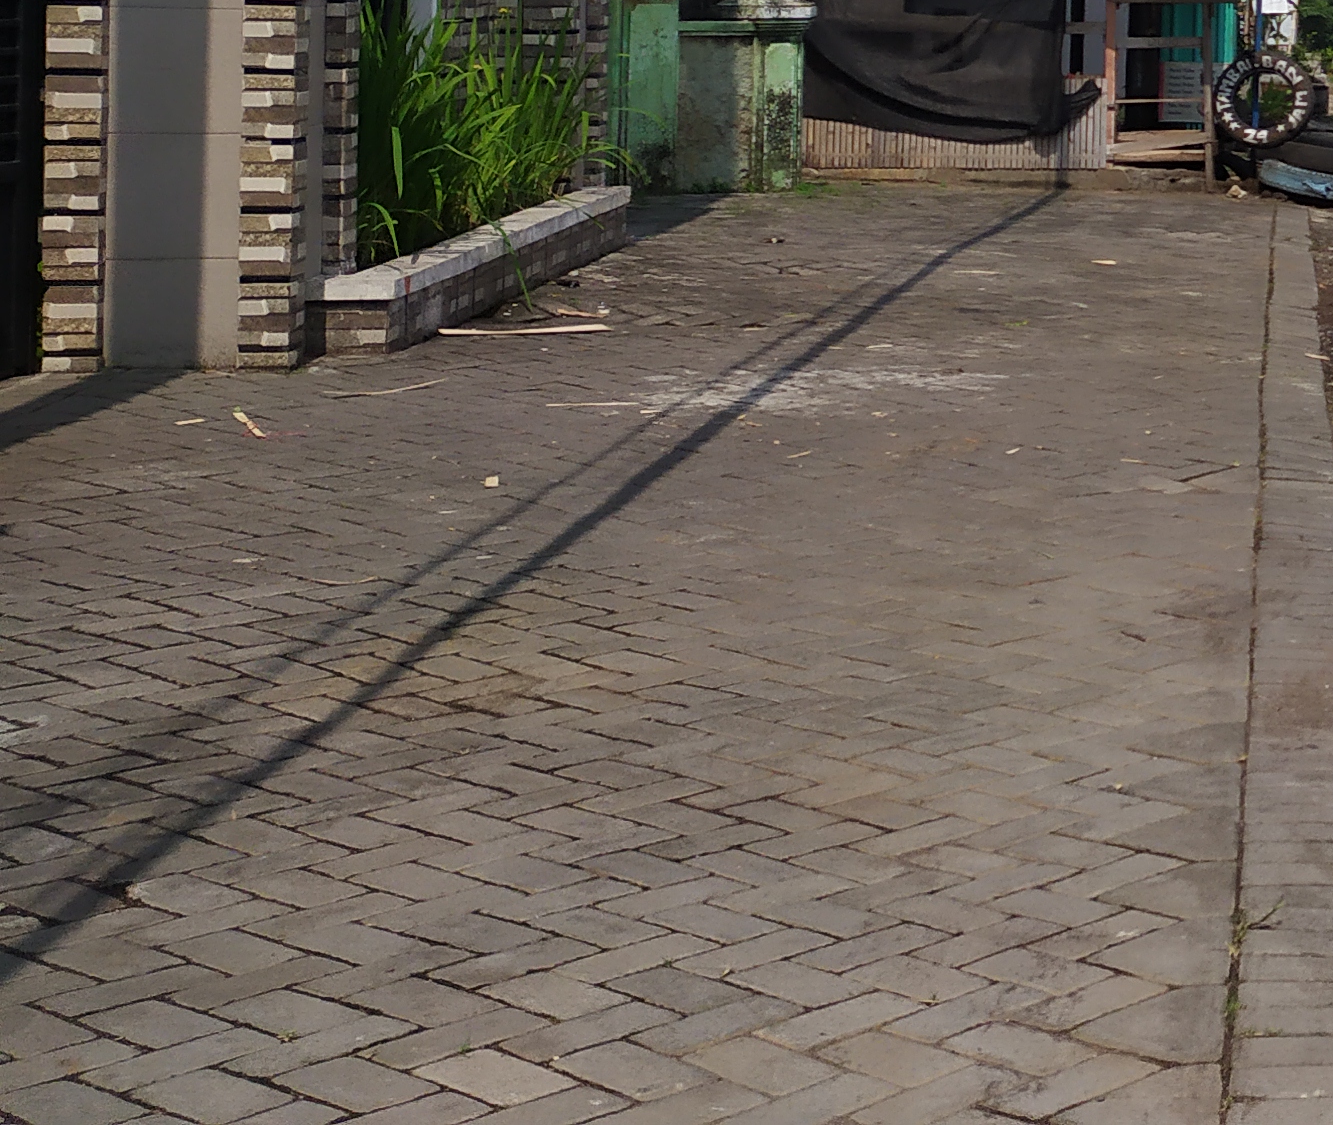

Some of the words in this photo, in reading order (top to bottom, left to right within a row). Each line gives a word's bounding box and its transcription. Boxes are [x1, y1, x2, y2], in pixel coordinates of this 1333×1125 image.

[1261, 55, 1304, 85] BAN
[1243, 128, 1269, 144] 24
[1288, 90, 1309, 129] JAM
